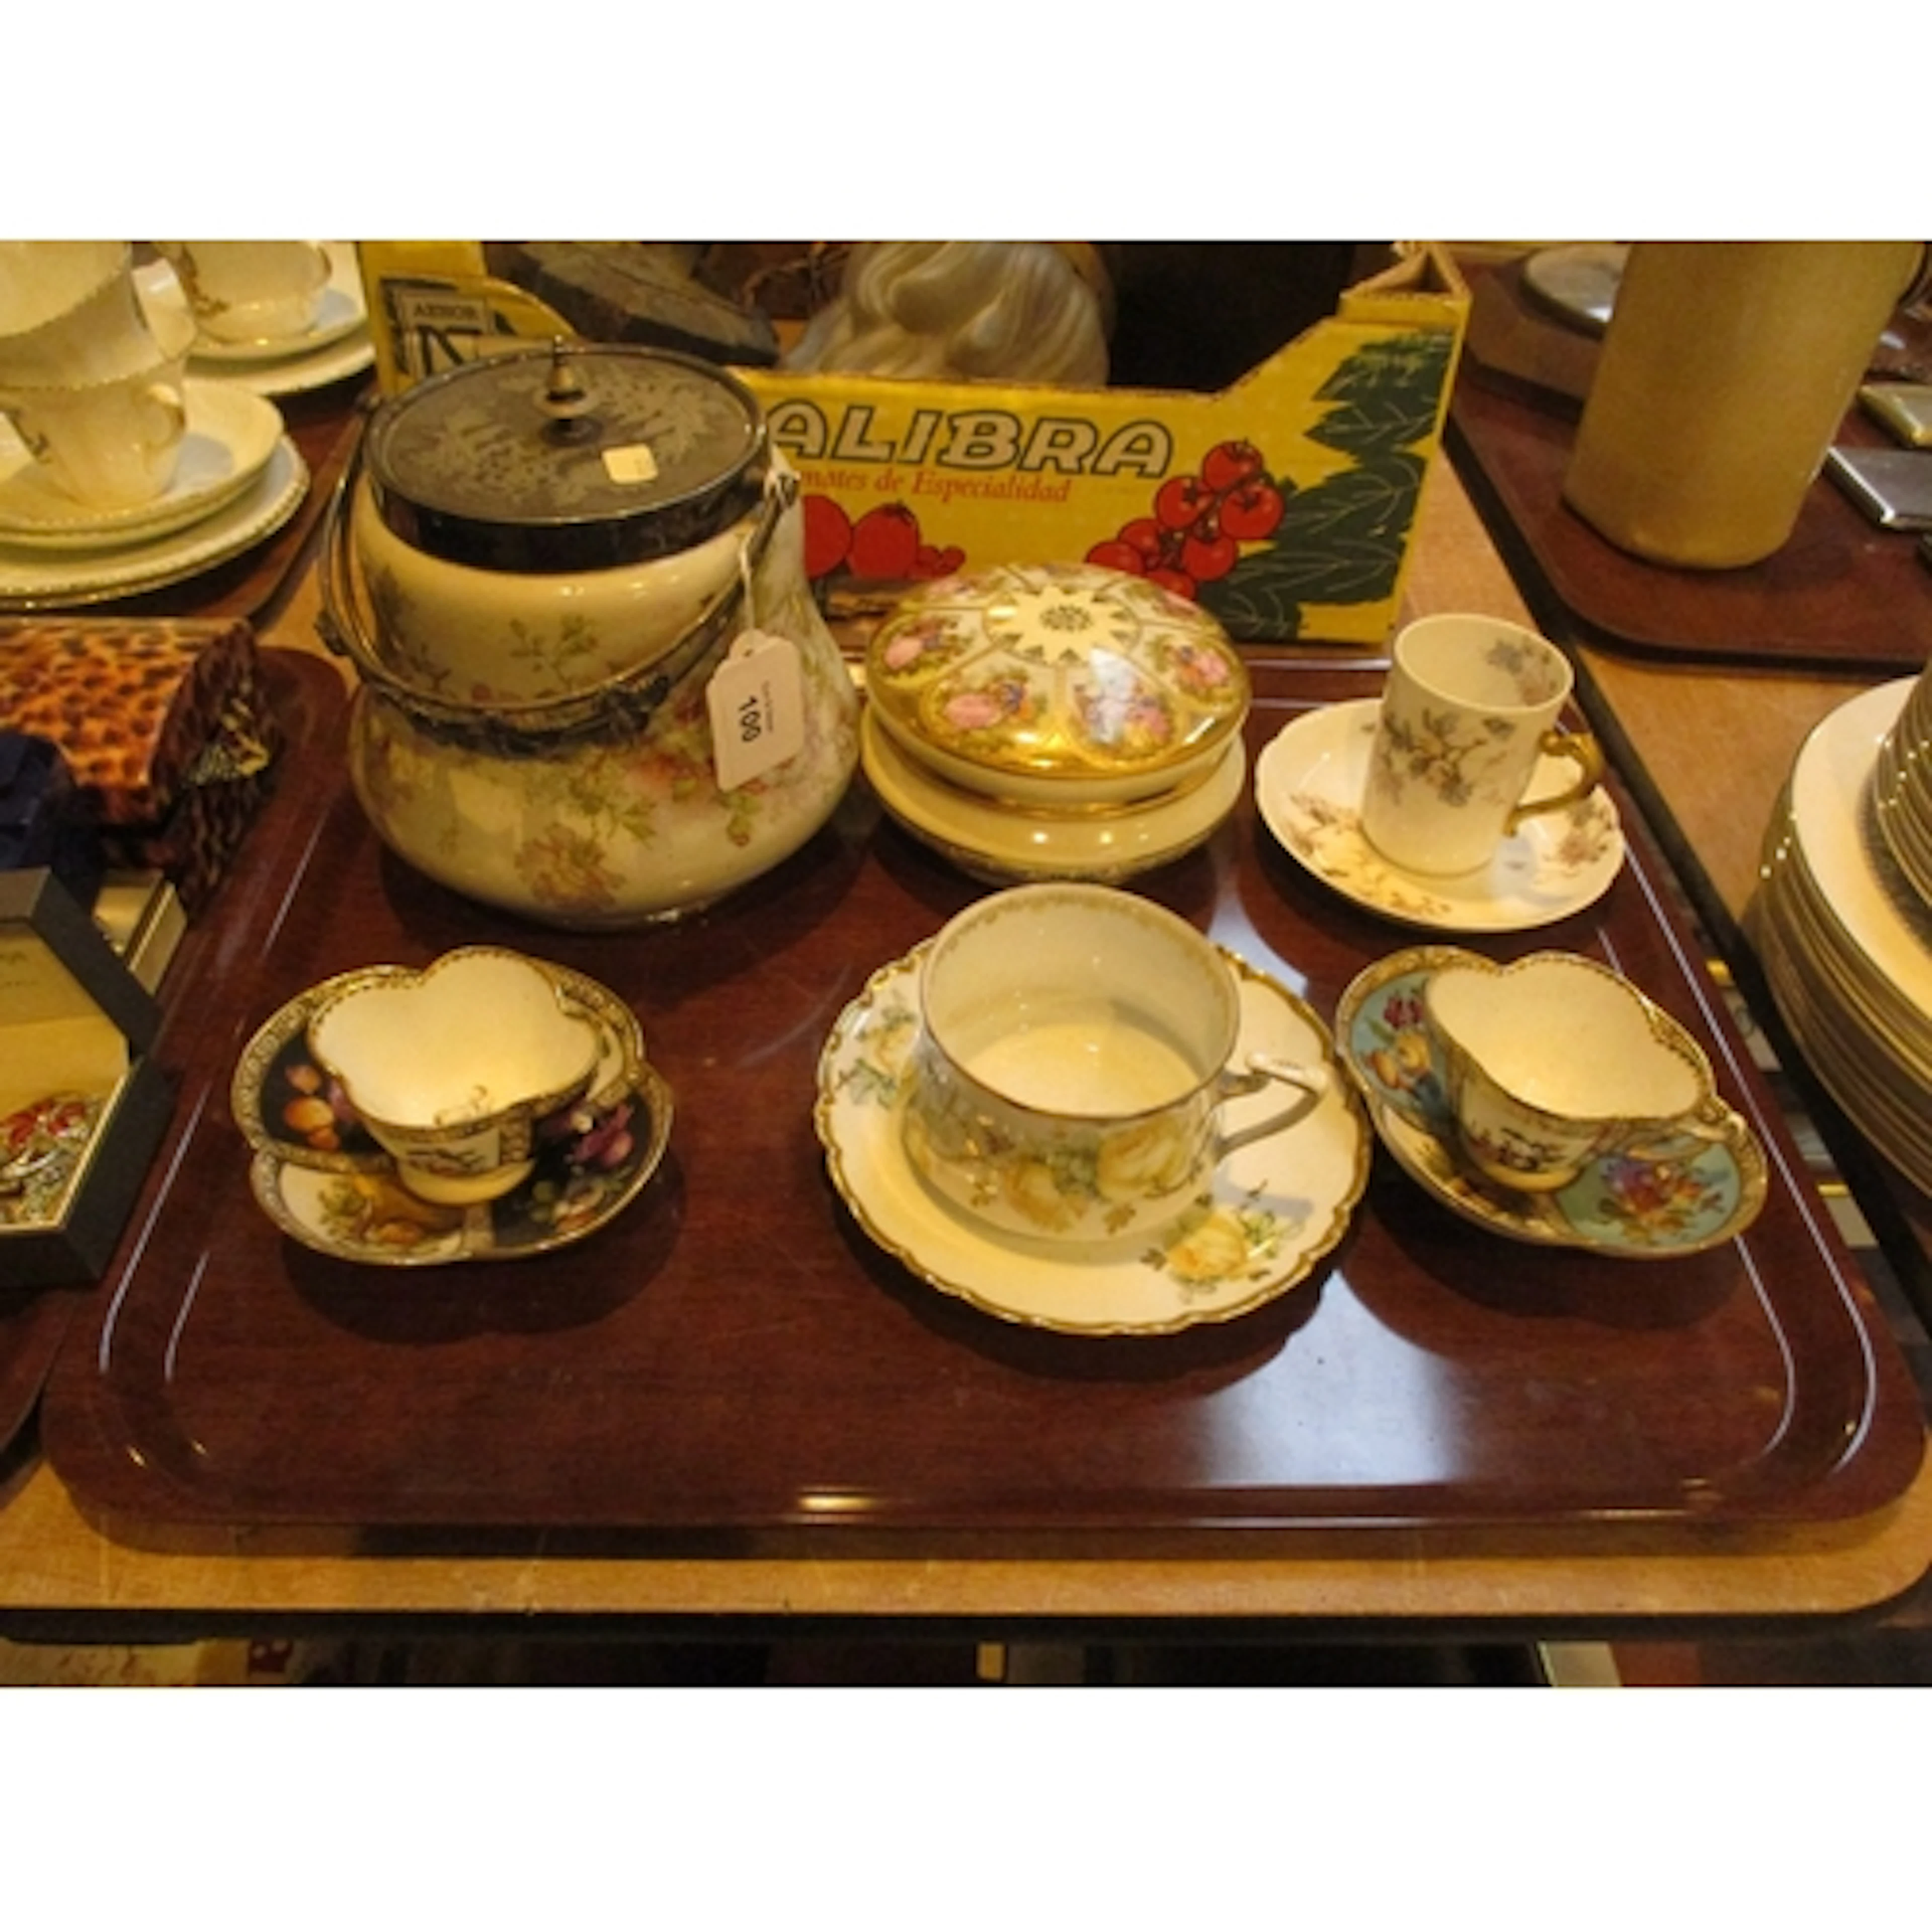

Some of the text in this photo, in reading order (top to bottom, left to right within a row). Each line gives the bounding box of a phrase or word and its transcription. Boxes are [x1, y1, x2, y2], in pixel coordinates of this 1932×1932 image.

[802, 467, 1071, 503] mates de Especialidad
[739, 696, 761, 743] 100
